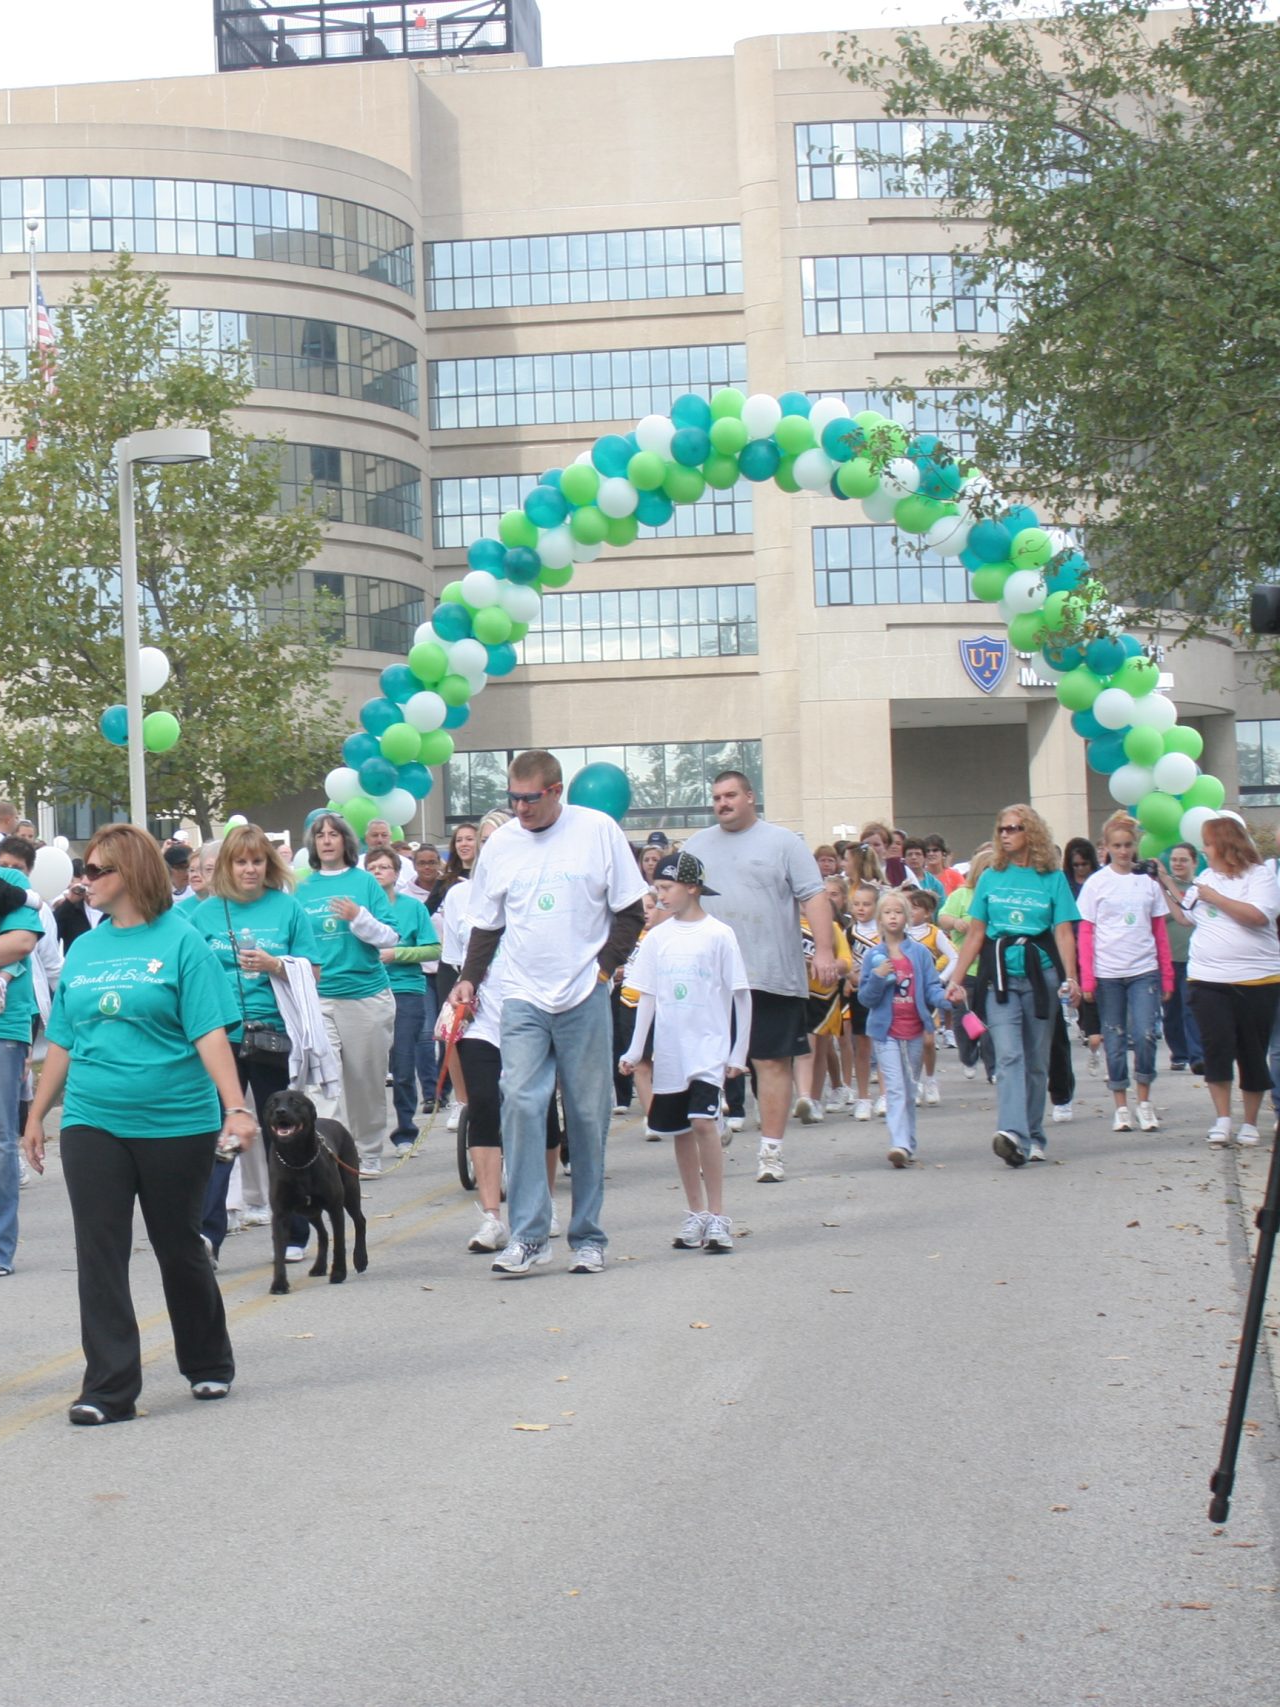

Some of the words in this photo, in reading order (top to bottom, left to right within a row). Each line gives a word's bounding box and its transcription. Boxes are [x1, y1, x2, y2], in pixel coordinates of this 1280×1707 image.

[968, 648, 1001, 670] UT
[69, 970, 109, 988] Break
[106, 969, 122, 982] the
